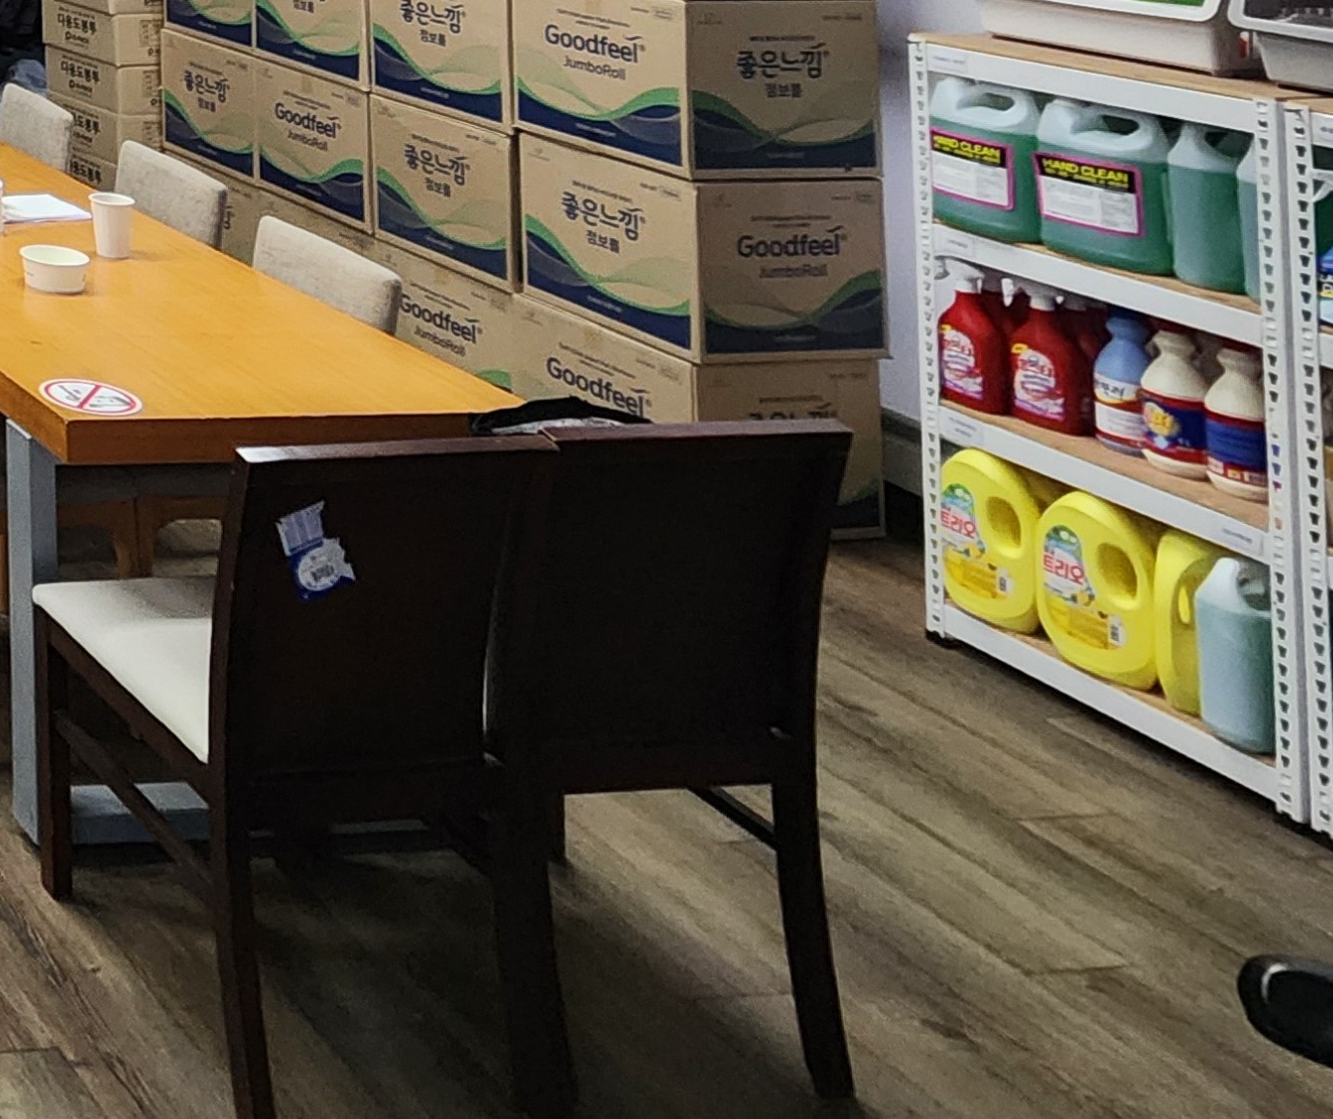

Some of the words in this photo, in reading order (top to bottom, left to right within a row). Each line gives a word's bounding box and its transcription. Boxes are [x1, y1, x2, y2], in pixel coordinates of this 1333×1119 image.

[545, 24, 642, 63] Goodfeel
[564, 56, 626, 80] JumboRoll
[737, 43, 826, 79] 좋은느낌
[184, 70, 228, 103] 좋은느낌
[275, 102, 339, 139] Goodfeel
[404, 143, 467, 186] 좋은느낌
[960, 141, 1001, 159] CLEAN
[1042, 158, 1079, 174] HAND
[1080, 166, 1129, 184] CLEAN
[561, 191, 644, 241] 좋은느낌
[586, 229, 620, 254] 점보롤
[737, 226, 842, 258] Goodfeel
[400, 293, 477, 344] Goodfeel
[547, 357, 646, 418] Goodfeel
[940, 509, 976, 539] 트리오
[1043, 554, 1085, 585] 트리오
